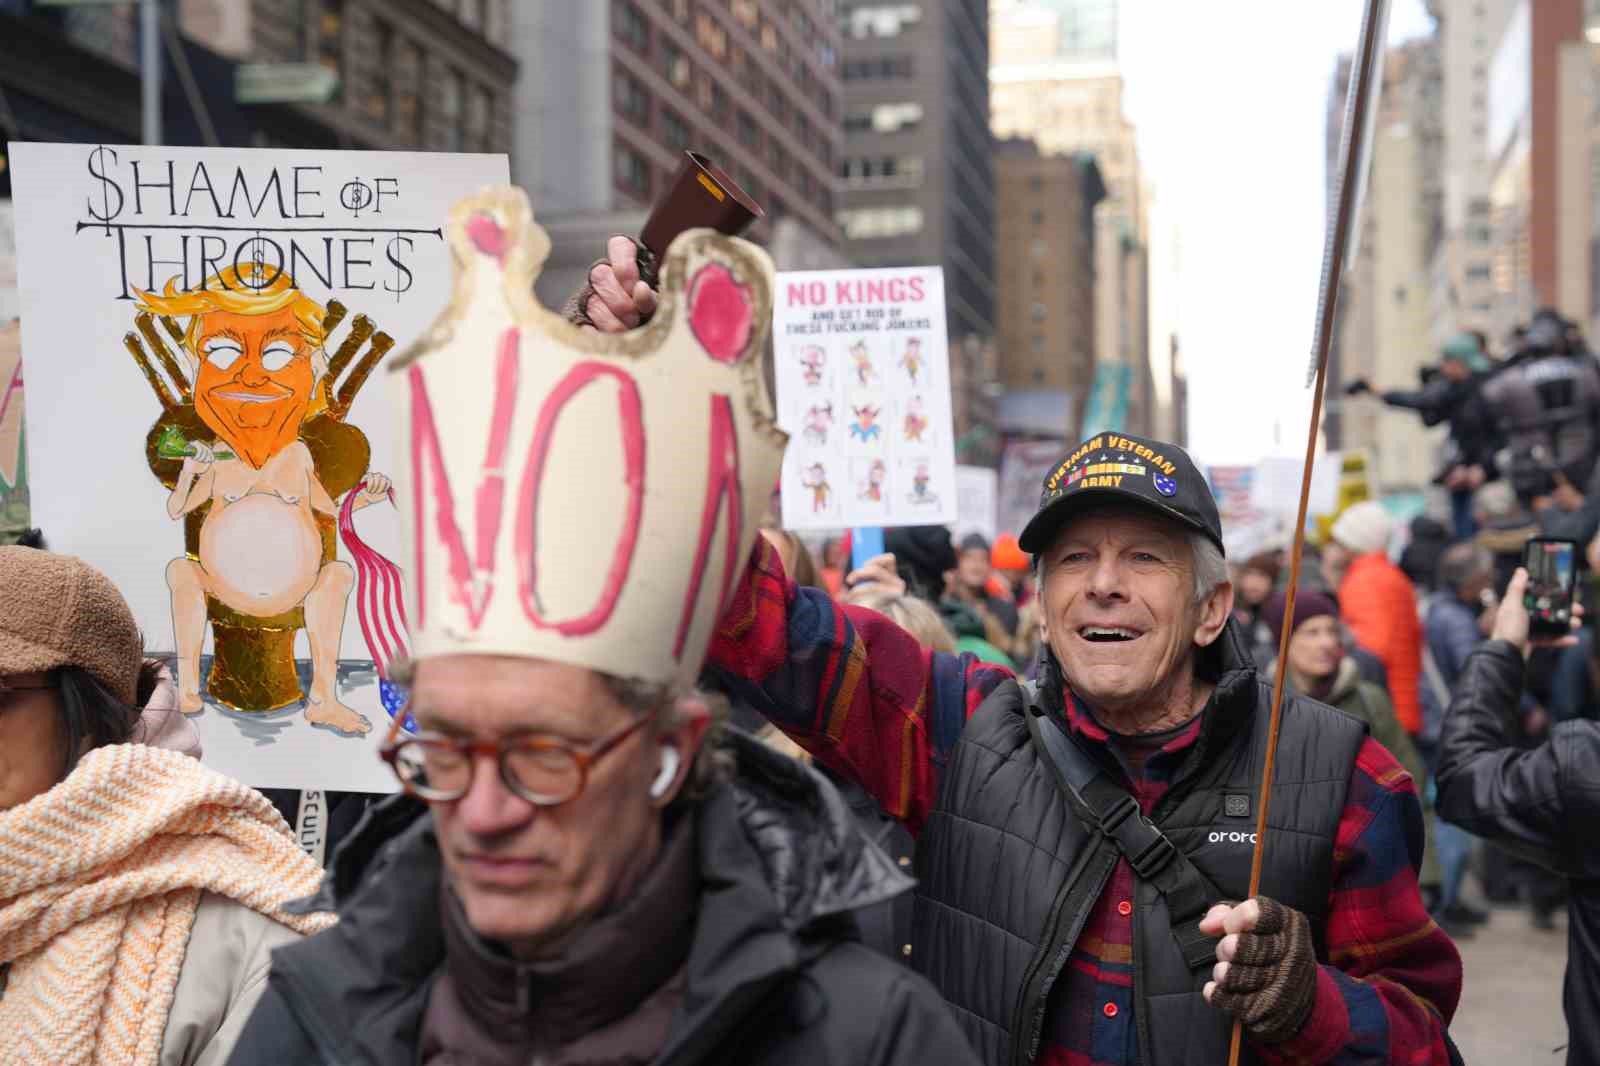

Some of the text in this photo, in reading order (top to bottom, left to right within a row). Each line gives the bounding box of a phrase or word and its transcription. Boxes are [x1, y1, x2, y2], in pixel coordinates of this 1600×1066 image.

[339, 176, 400, 218] OF
[786, 275, 926, 307] NO KINGS
[786, 318, 931, 334] THESE FUCKING JOKERS
[812, 309, 834, 320] AND
[1047, 435, 1176, 490] VIETNAM VETERAN
[1080, 475, 1123, 488] ARMY
